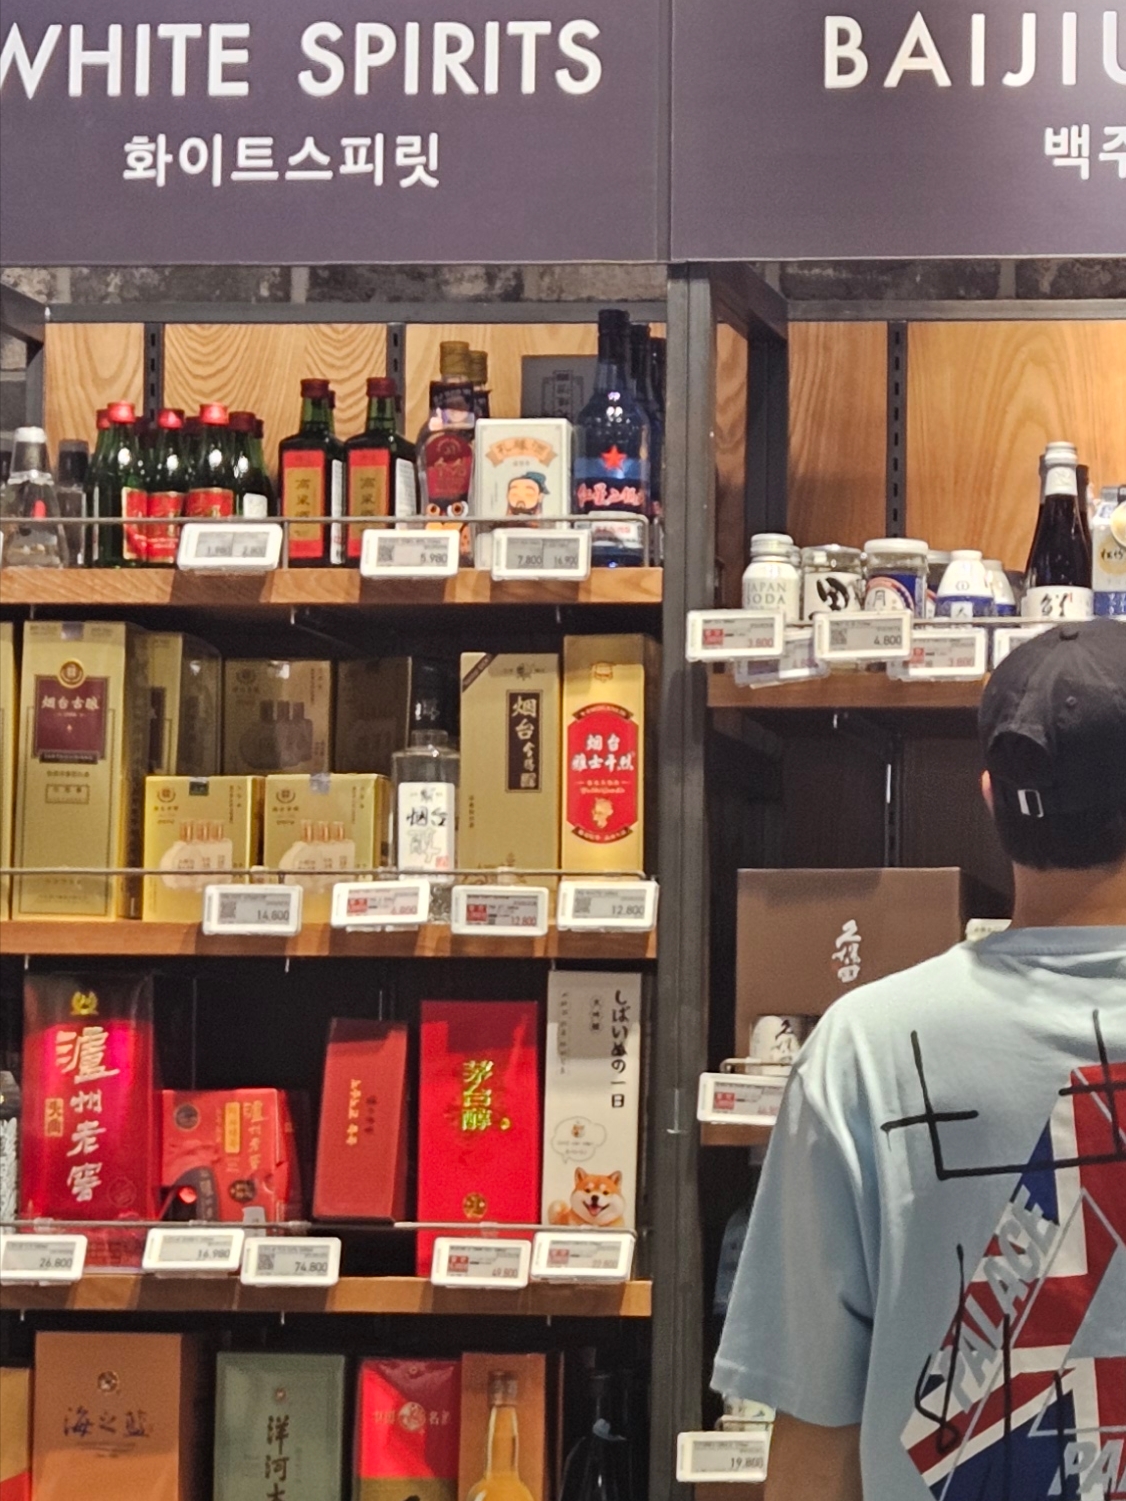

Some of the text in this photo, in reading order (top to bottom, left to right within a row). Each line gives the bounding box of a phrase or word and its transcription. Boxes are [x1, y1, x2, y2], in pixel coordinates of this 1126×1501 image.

[297, 19, 602, 96] SPIRITS
[123, 133, 440, 188] 화이트스피릿
[874, 635, 902, 646] 4.800
[586, 734, 621, 751] 烟台
[256, 909, 290, 922] 14.800
[612, 904, 644, 916] 12.800
[610, 989, 631, 1108] しばいぬの一日
[40, 1257, 72, 1268] 26.800
[295, 1261, 327, 1272] 74.800
[946, 1185, 1061, 1413] PALACE
